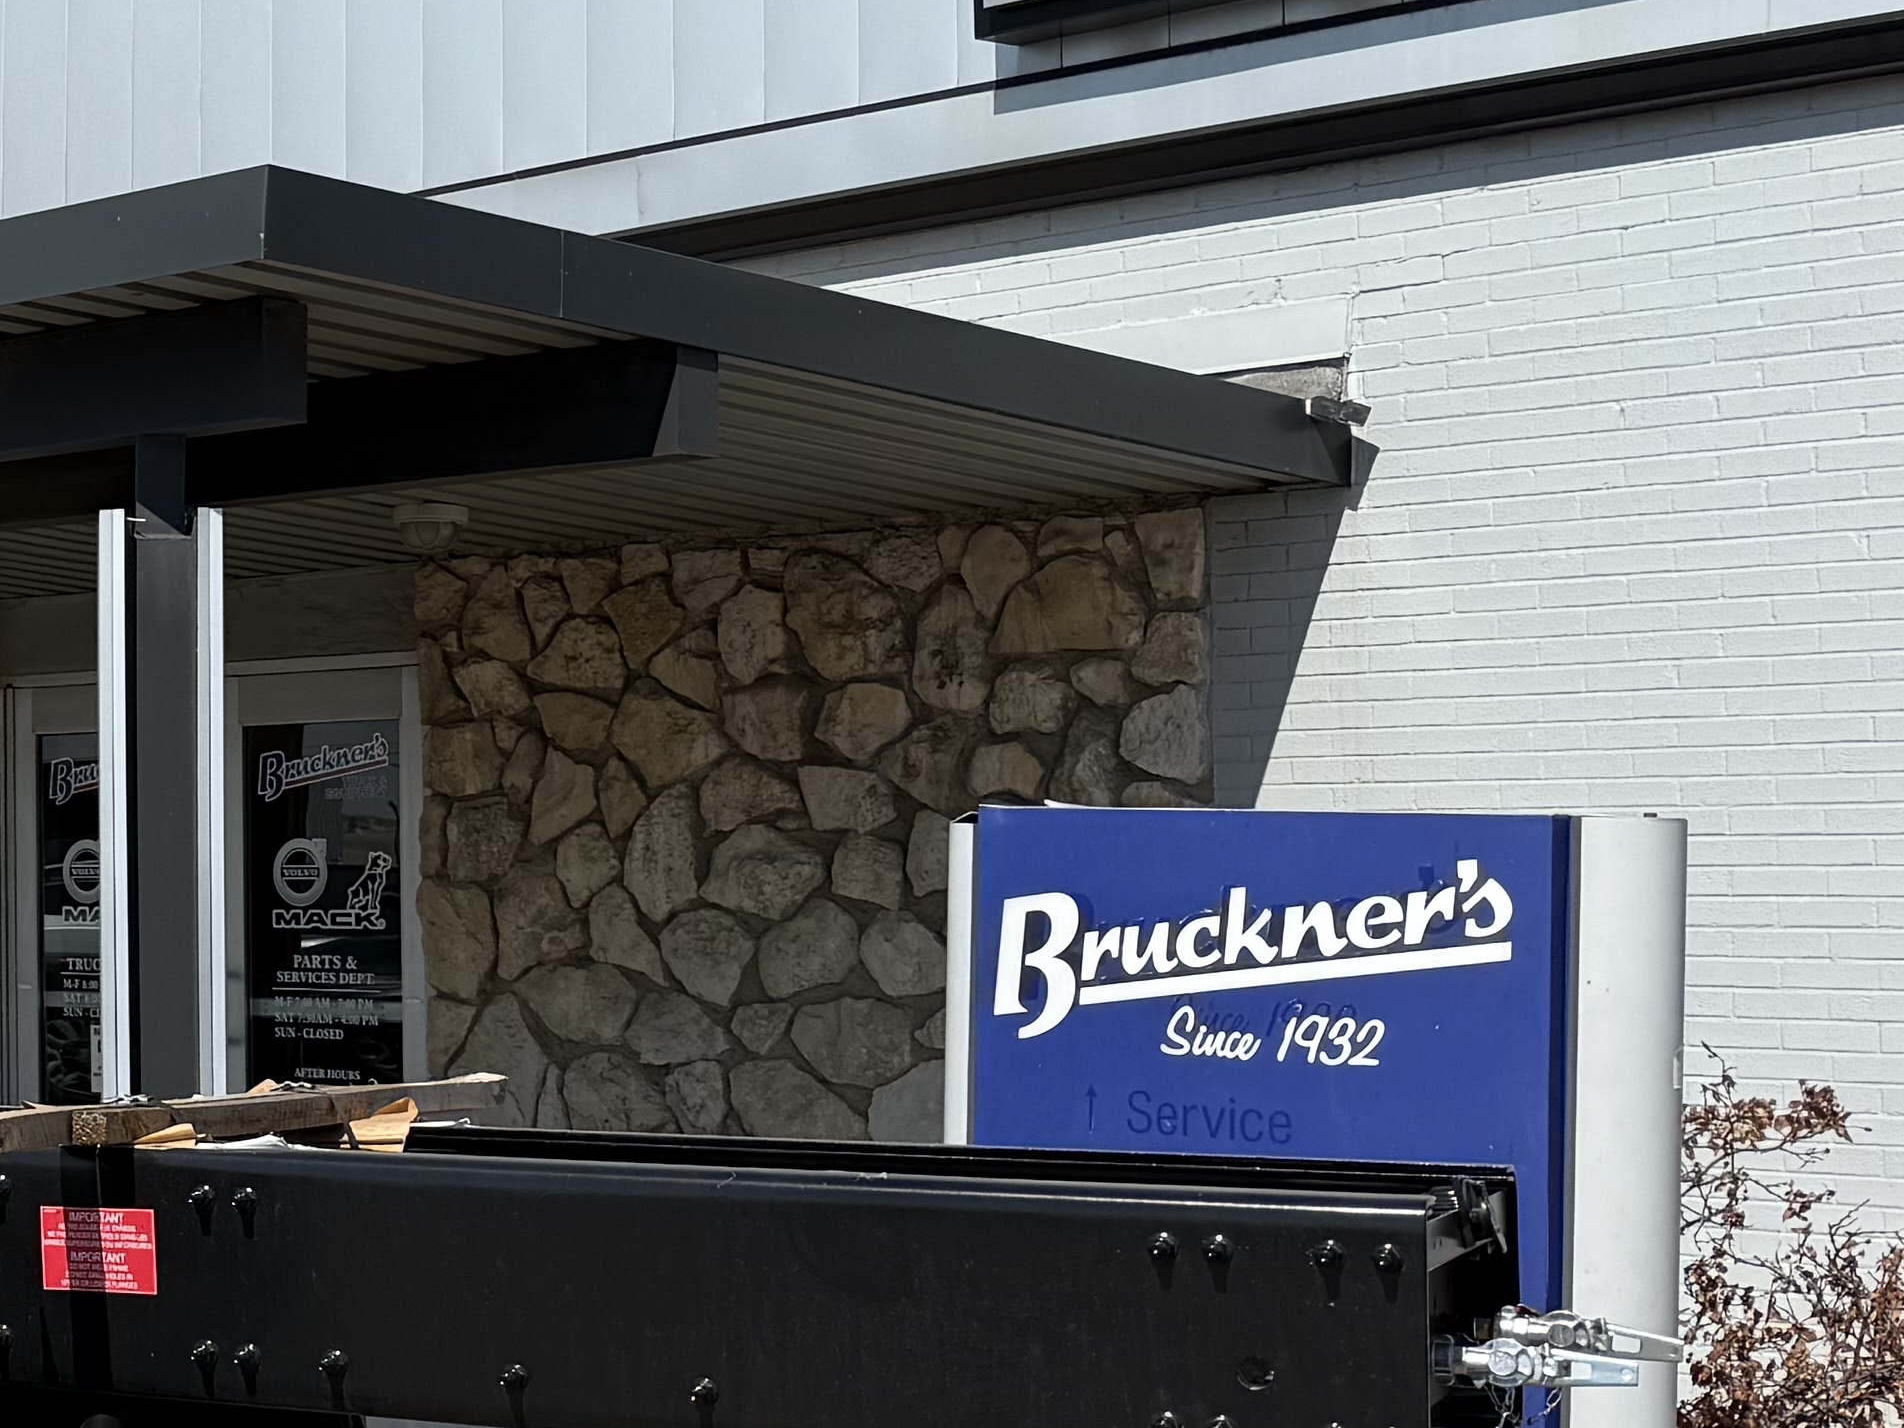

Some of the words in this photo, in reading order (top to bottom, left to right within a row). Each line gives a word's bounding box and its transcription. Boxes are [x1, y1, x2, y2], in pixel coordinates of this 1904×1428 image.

[257, 732, 389, 803] Bruckner's
[272, 909, 380, 930] MACK
[992, 858, 1514, 1040] Bruckner's
[293, 954, 342, 969] PARTS
[345, 955, 358, 970] &
[276, 971, 337, 984] SERVICES
[274, 1026, 296, 1038] SUN
[302, 1027, 345, 1040] CLOSED
[1159, 1005, 1262, 1063] Since
[1276, 1015, 1386, 1068] 1932
[294, 1067, 325, 1079] AFTER
[326, 1069, 361, 1081] HOURS
[1125, 1089, 1294, 1146] Service
[68, 1211, 125, 1224] IMPORTANT
[70, 1251, 127, 1264] IMPORTANT
